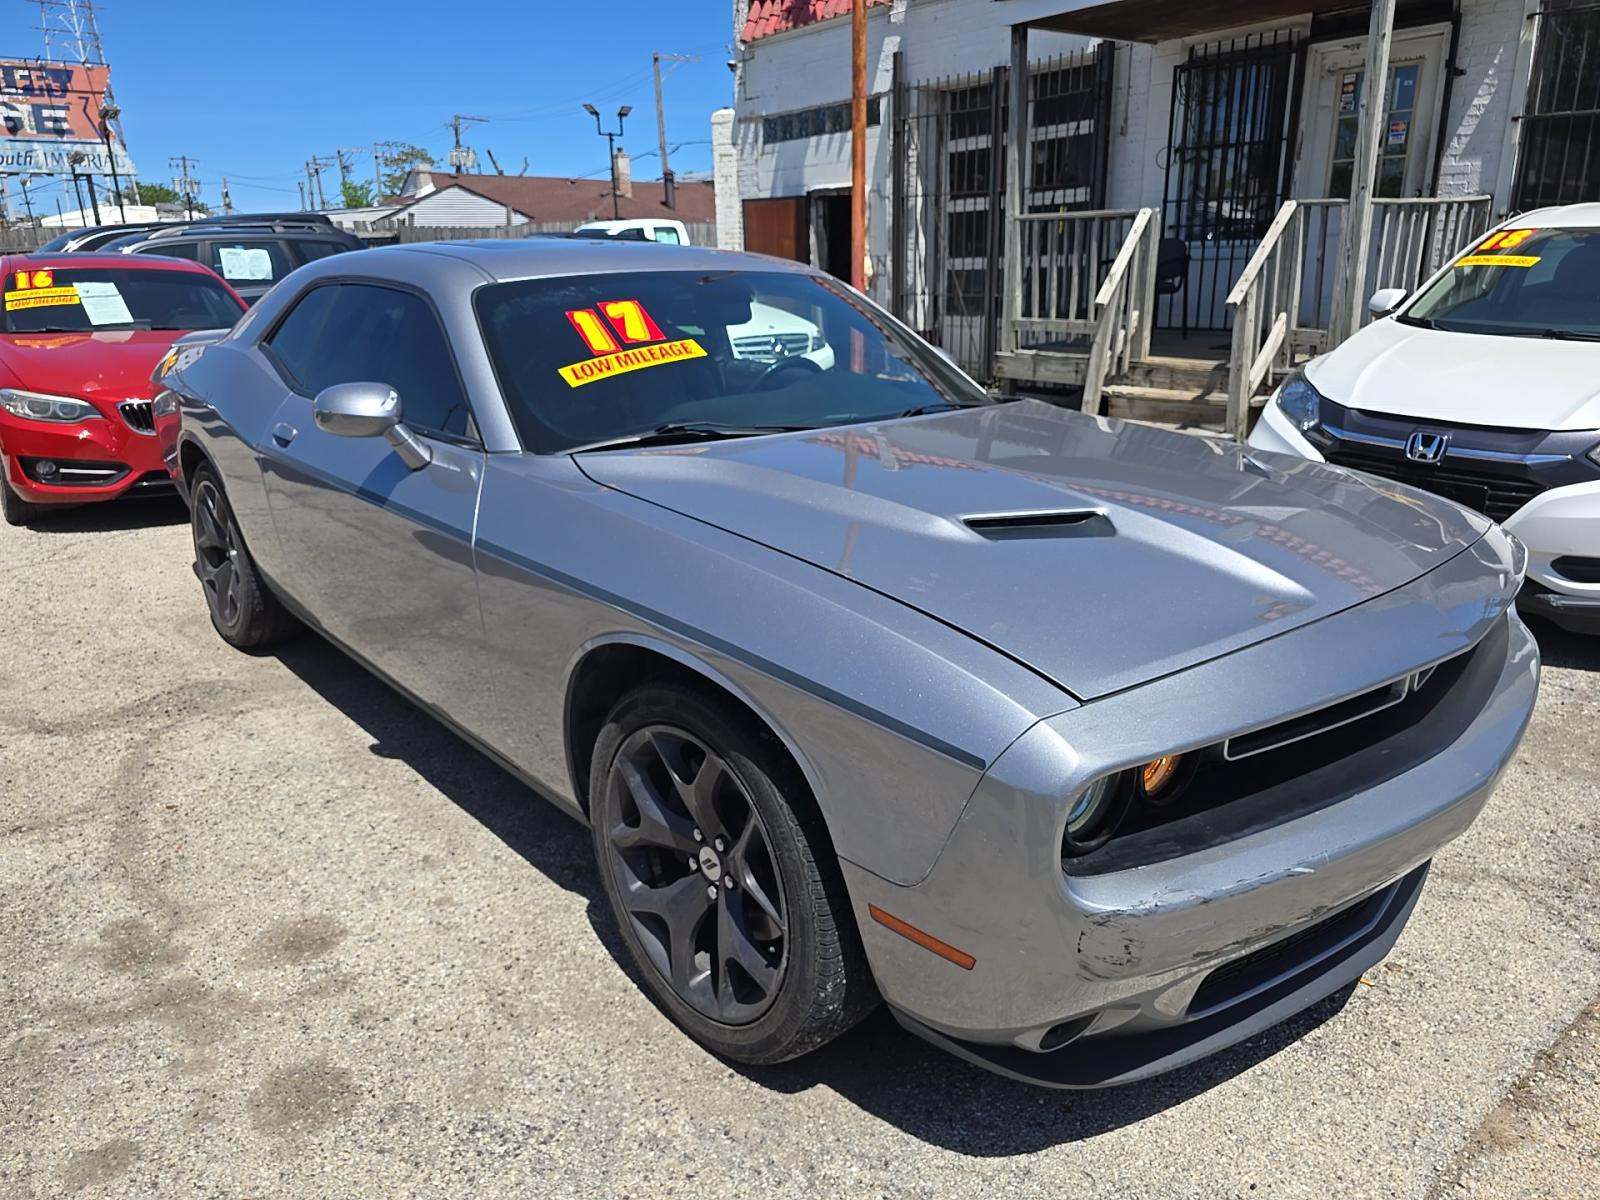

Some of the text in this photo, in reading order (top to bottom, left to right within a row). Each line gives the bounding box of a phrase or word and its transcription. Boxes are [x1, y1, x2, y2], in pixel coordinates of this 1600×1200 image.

[1478, 229, 1532, 250] 18
[17, 271, 53, 290] 16
[572, 300, 652, 351] 17
[570, 342, 694, 380] LOW MILEAGE
